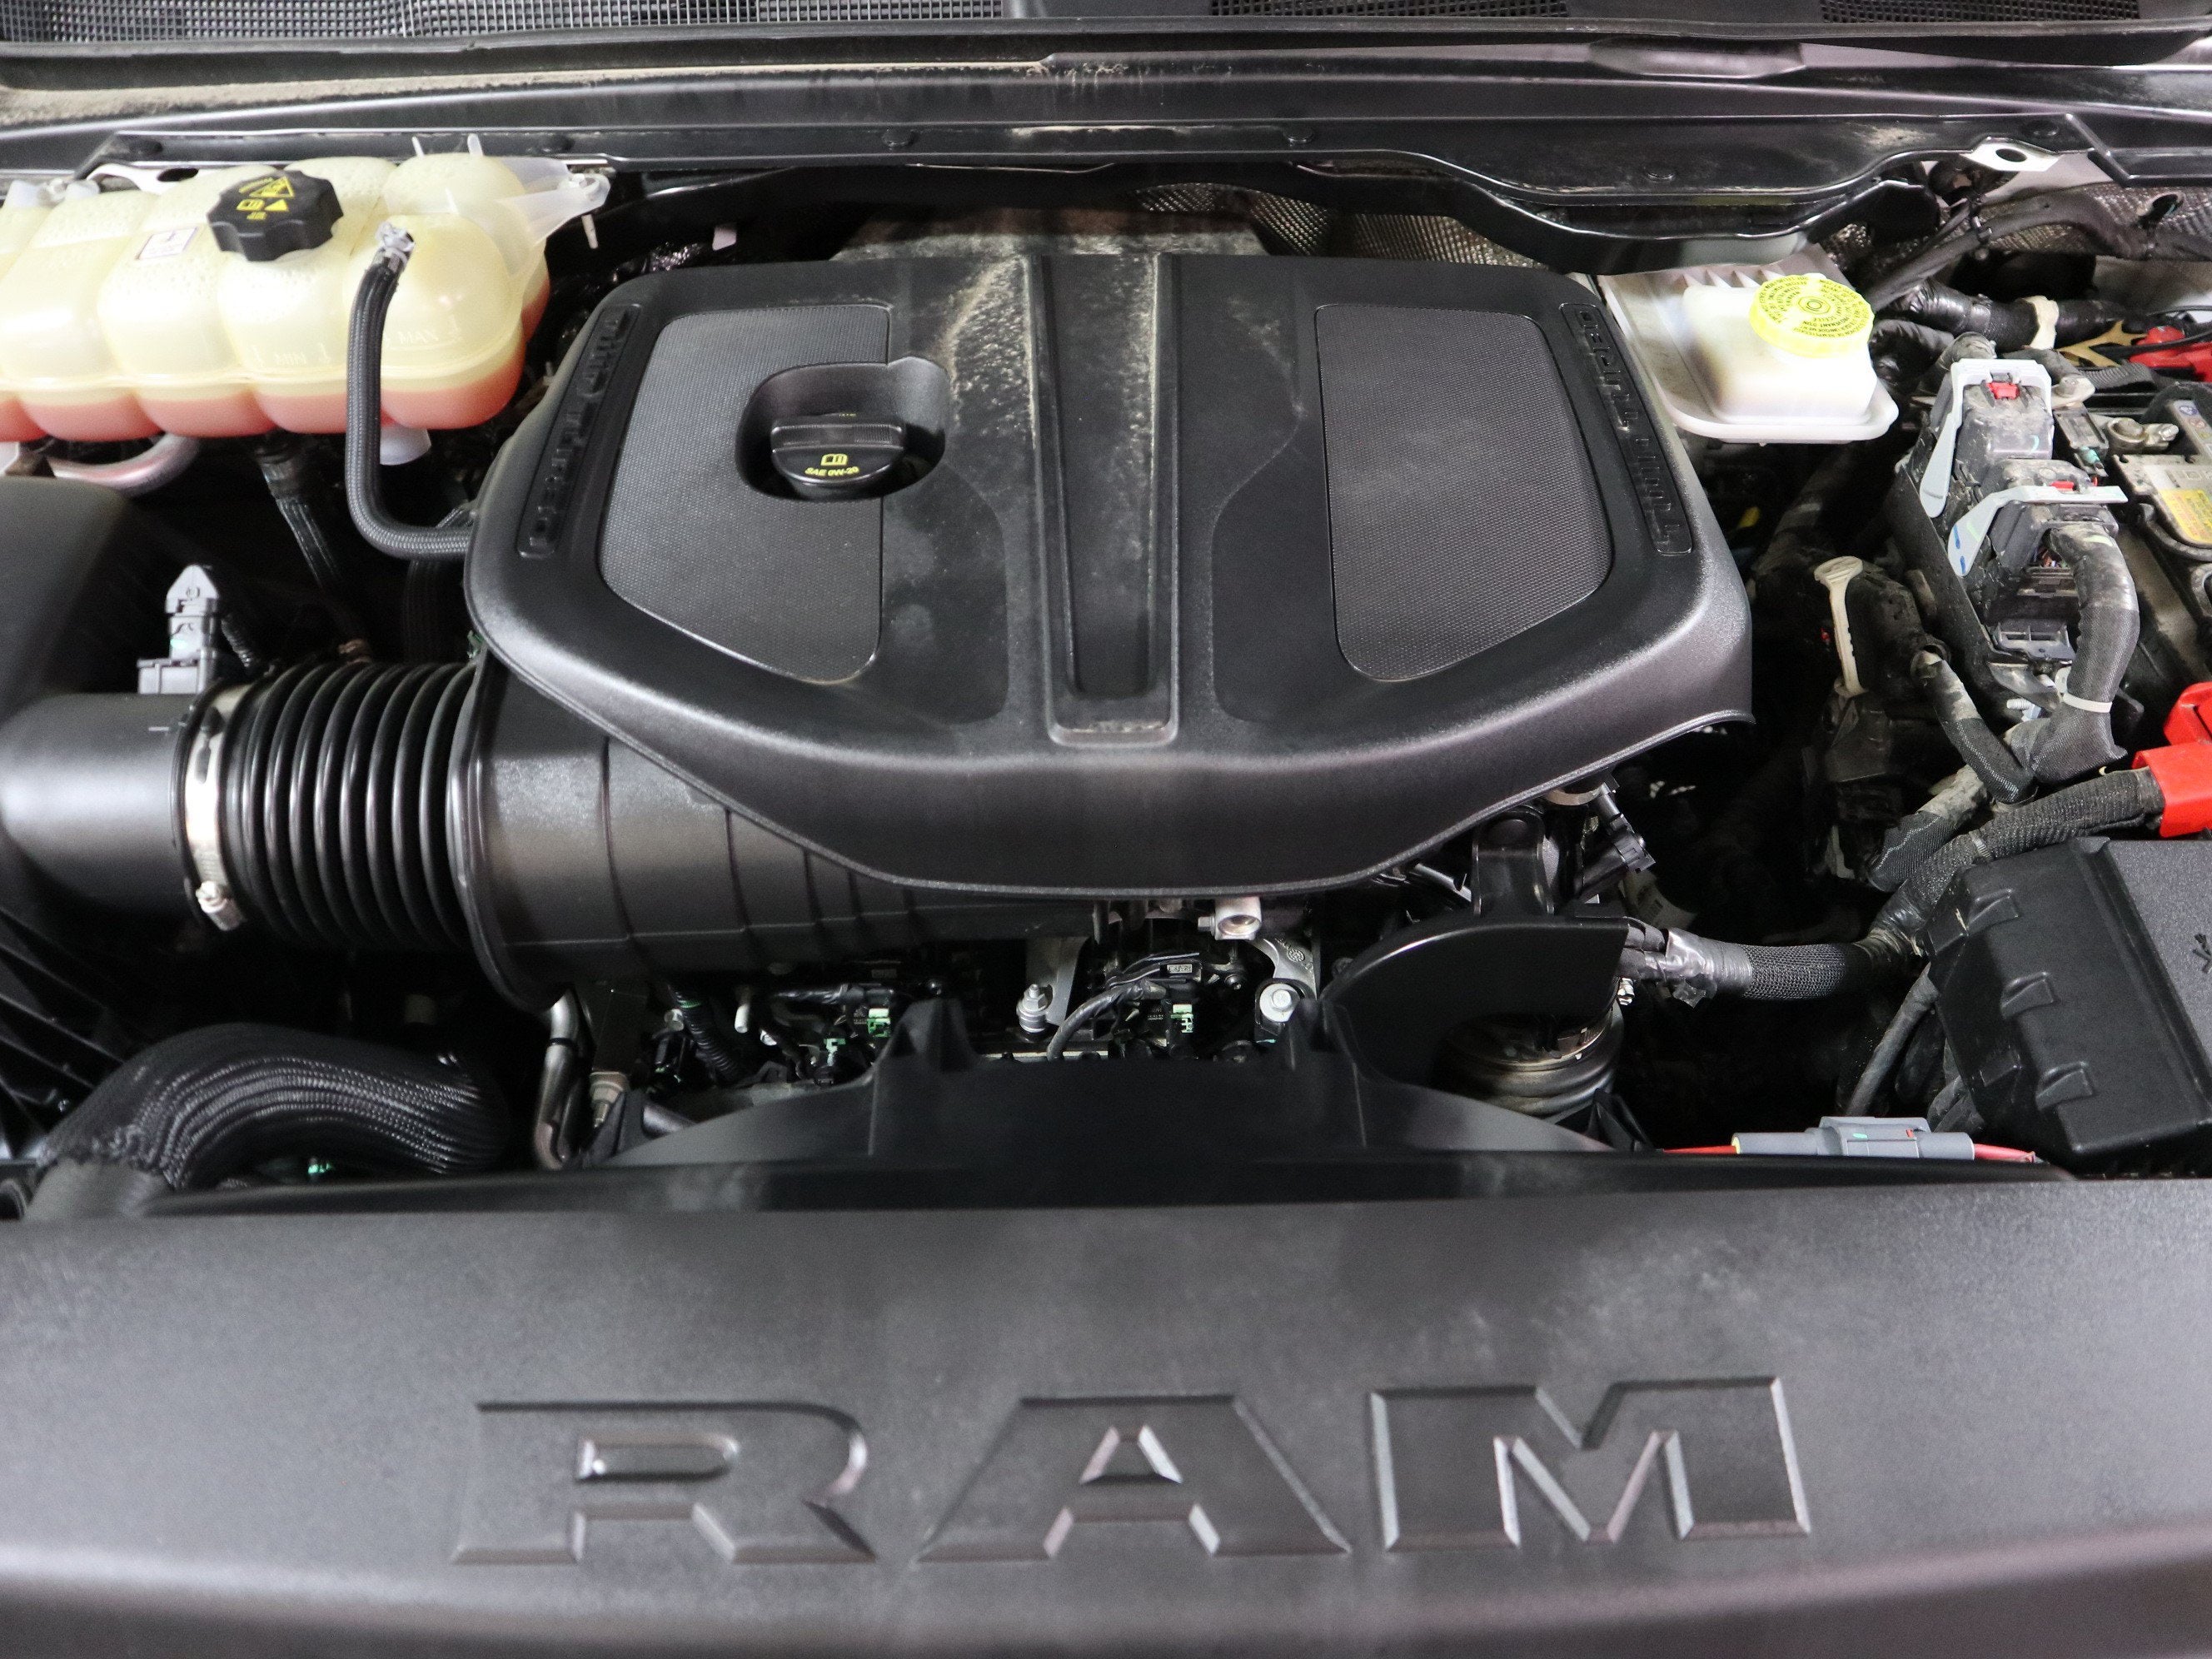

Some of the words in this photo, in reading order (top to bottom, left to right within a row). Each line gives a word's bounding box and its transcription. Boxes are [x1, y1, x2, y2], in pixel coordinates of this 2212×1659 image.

[805, 467, 826, 476] SAE
[827, 466, 859, 476] 0W-20
[450, 1374, 1811, 1562] RAM
